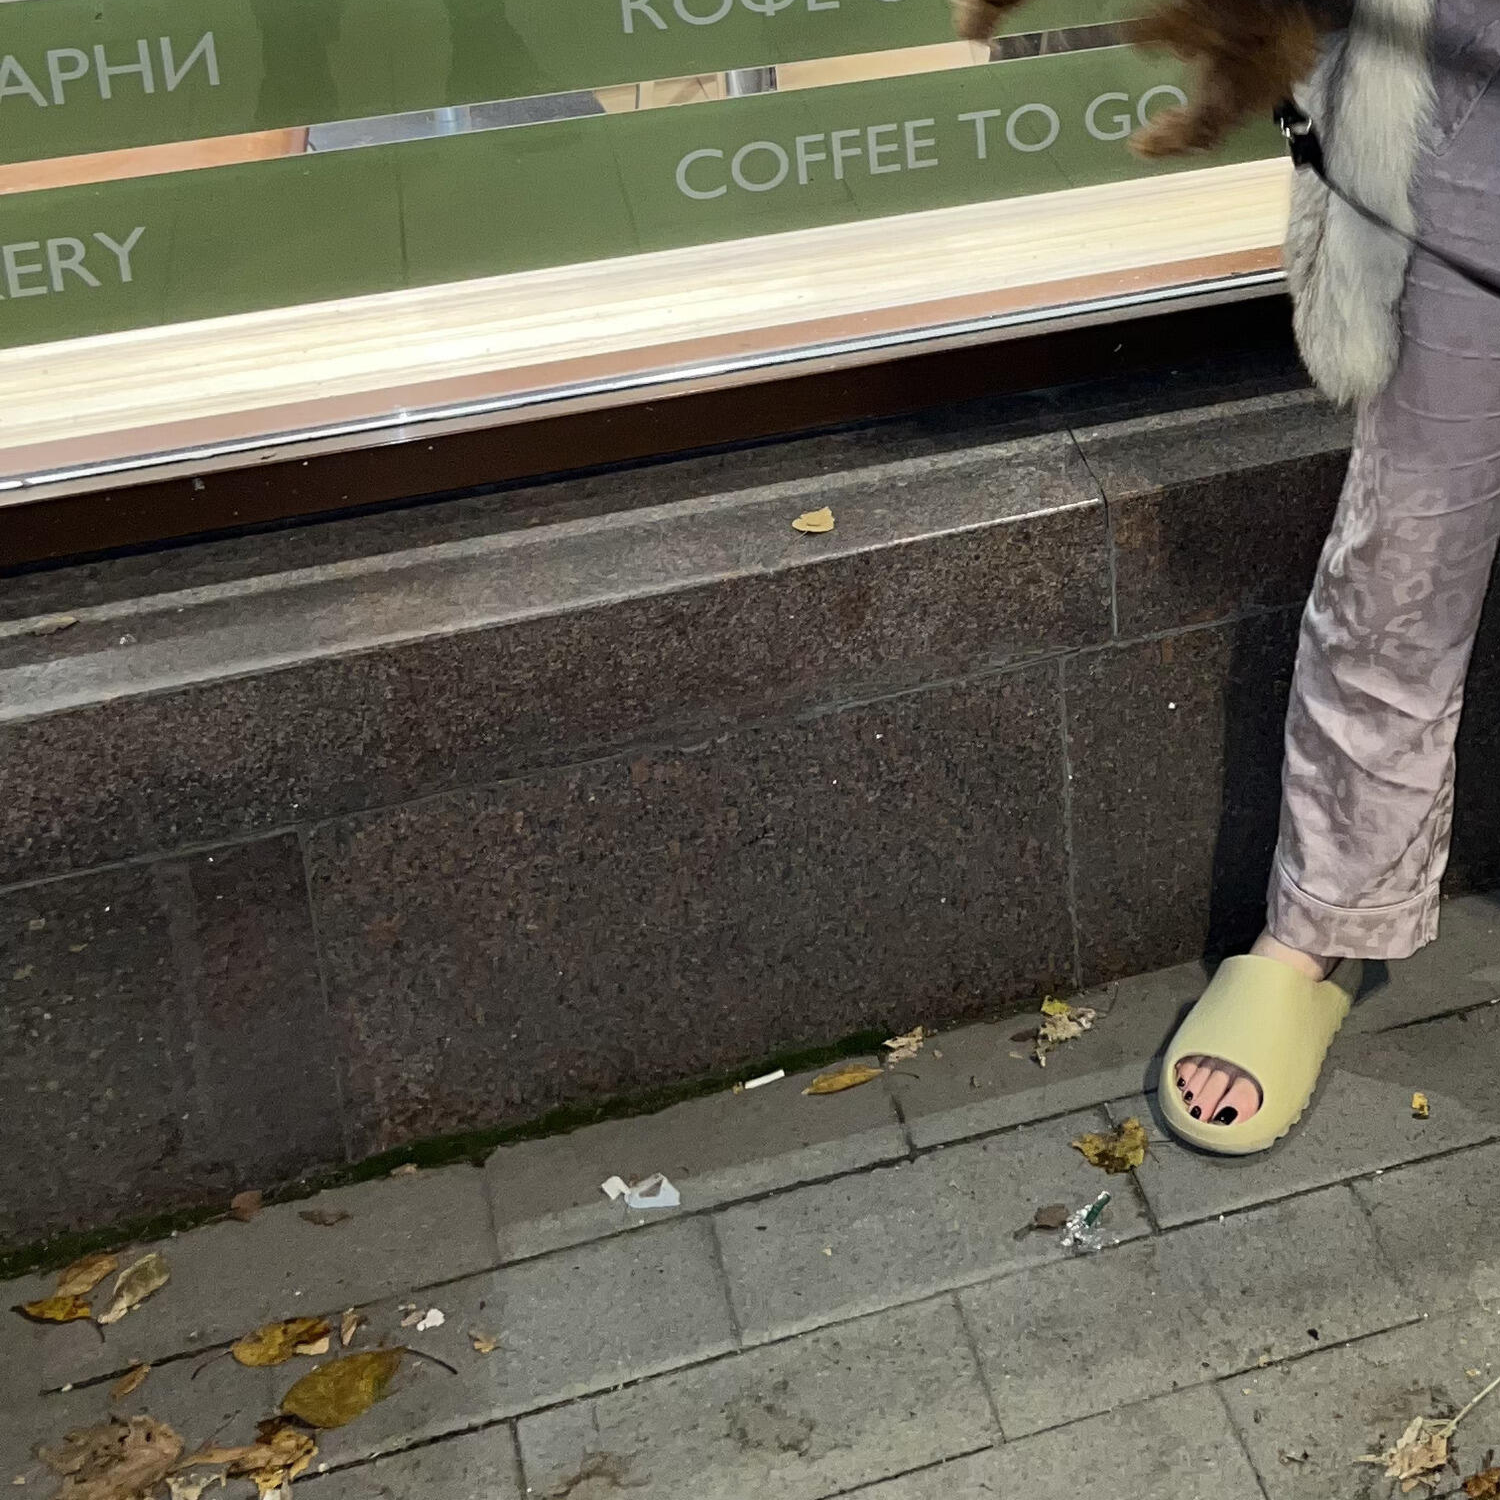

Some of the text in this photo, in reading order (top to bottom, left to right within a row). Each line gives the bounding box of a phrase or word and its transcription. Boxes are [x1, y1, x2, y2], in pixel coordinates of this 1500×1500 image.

[675, 84, 1189, 201] COFFEE TO GO
[0, 226, 146, 301] ERY
